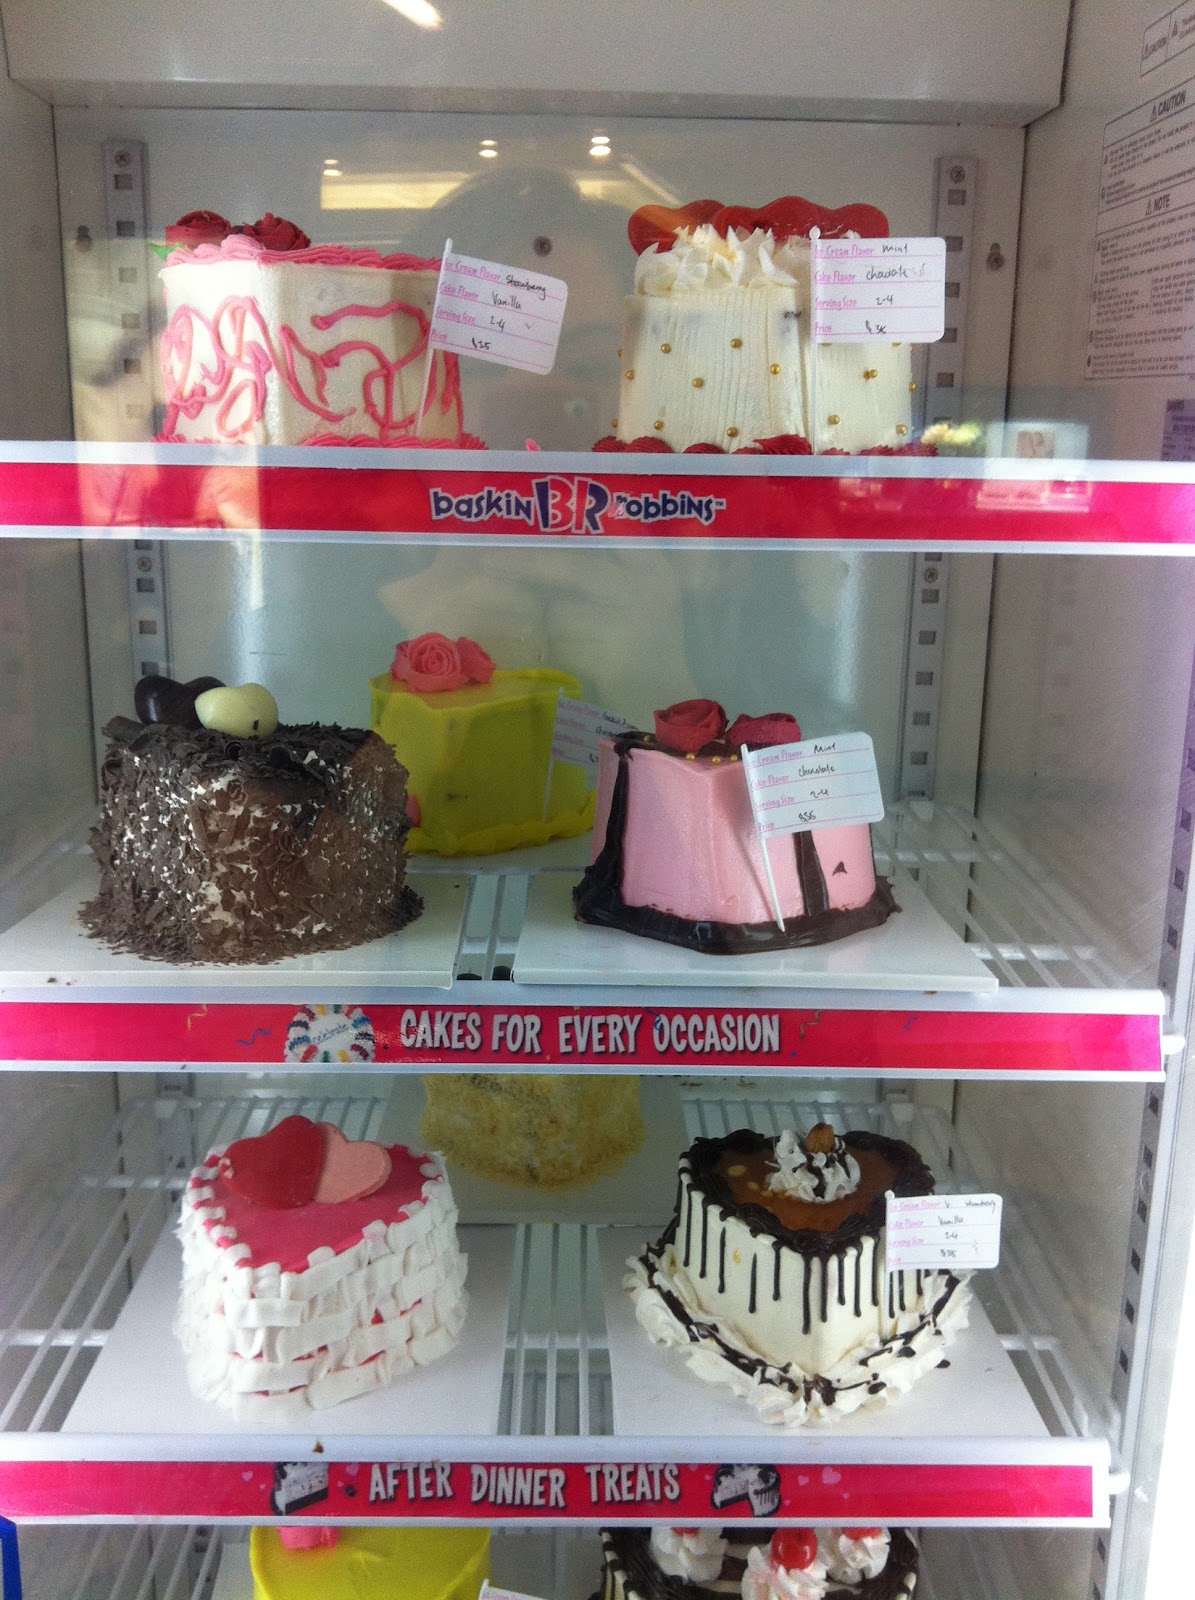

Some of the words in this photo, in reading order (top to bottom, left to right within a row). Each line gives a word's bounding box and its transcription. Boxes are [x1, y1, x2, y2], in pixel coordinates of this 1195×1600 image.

[1158, 90, 1186, 116] CAUTION
[1154, 193, 1171, 212] NOTE
[826, 244, 849, 256] Cream
[851, 244, 875, 256] Flavor
[455, 261, 477, 275] Cream
[479, 267, 500, 281] Flavor
[814, 271, 831, 282] Cake
[833, 270, 856, 282] Flavor
[440, 282, 457, 295] Cake
[458, 286, 479, 300] Flavor
[815, 297, 841, 311] Serving
[842, 296, 858, 308] Size
[875, 294, 894, 306] 2-4
[462, 312, 476, 324] Size
[814, 322, 832, 333] Price
[430, 487, 533, 526] baskin
[532, 475, 612, 534] BR
[781, 750, 802, 761] Flavor
[768, 775, 790, 786] Flavor
[781, 794, 795, 806] Size
[400, 1008, 481, 1052] CAKES
[491, 1013, 541, 1053] FOR
[558, 1014, 643, 1053] EVERY
[653, 1014, 781, 1053] OCCASION
[920, 1200, 941, 1209] Flavor
[905, 1219, 924, 1228] Flavor
[369, 1462, 453, 1501] AFTER
[471, 1465, 566, 1507] DINNER
[585, 1463, 680, 1502] TREATS
